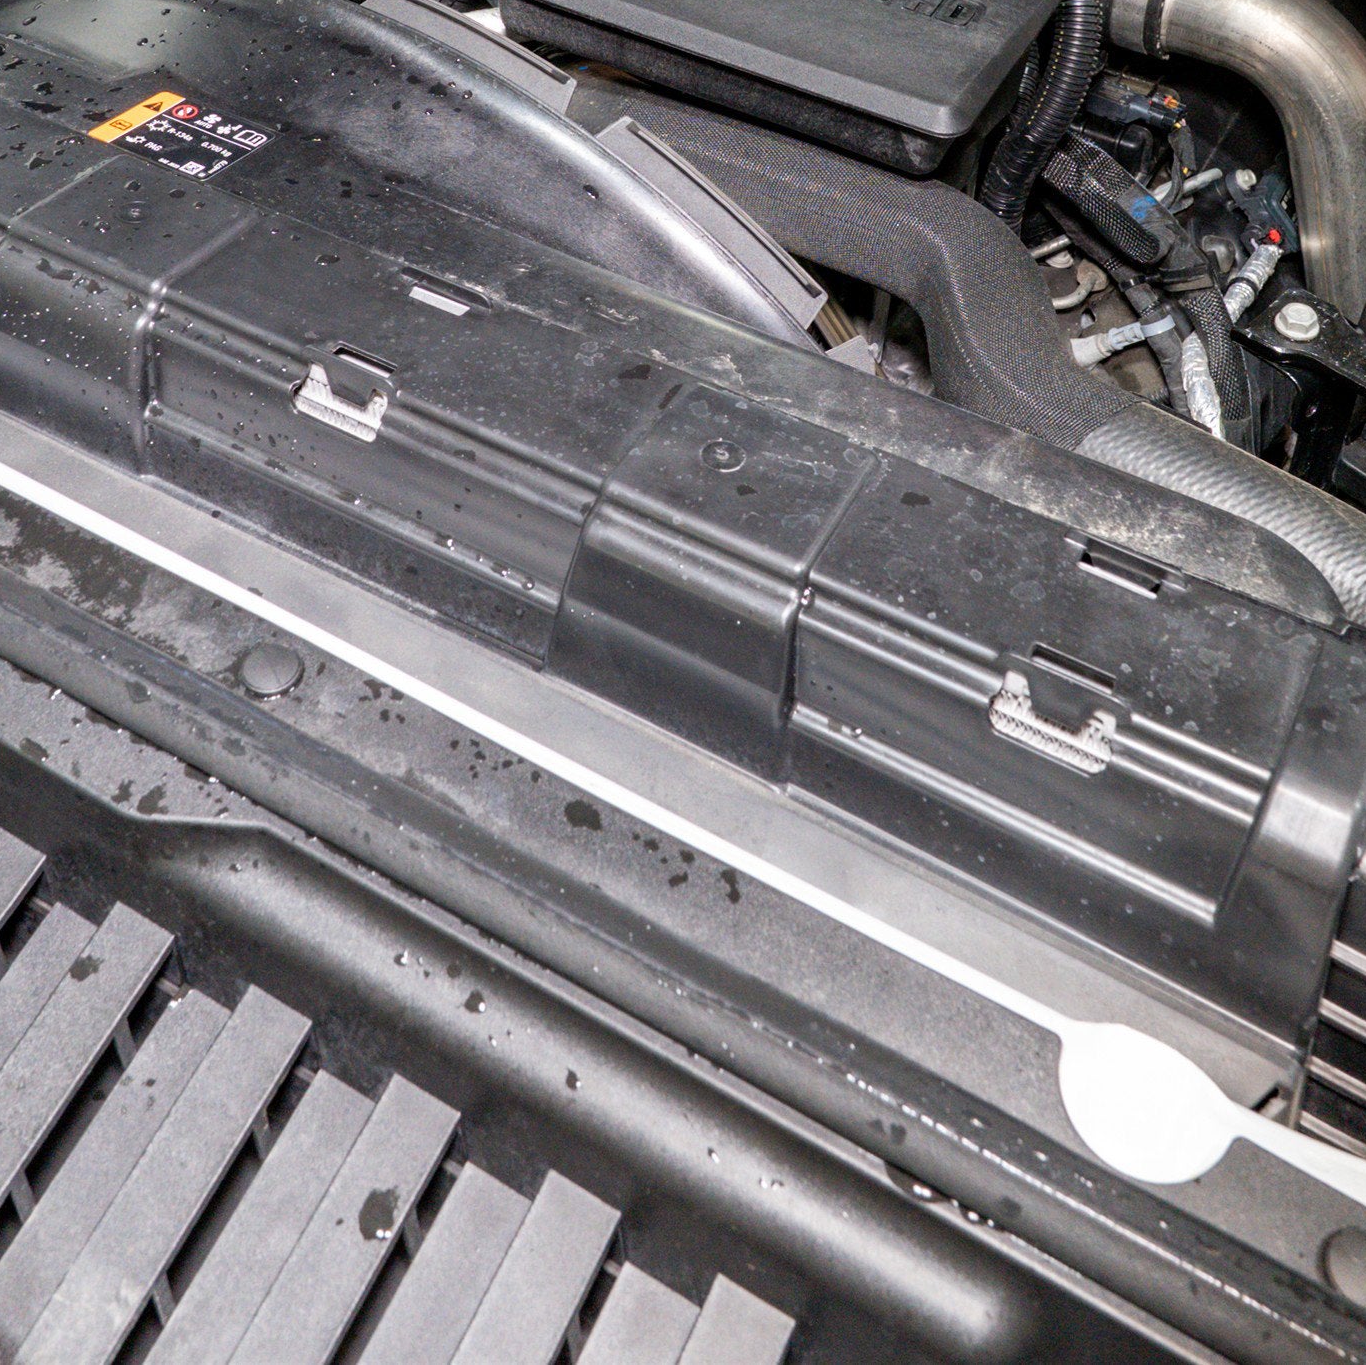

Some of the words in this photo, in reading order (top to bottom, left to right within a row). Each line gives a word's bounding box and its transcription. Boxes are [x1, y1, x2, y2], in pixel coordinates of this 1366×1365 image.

[193, 119, 213, 129] AUTO
[166, 127, 194, 142] R-134a
[144, 141, 163, 152] PAG
